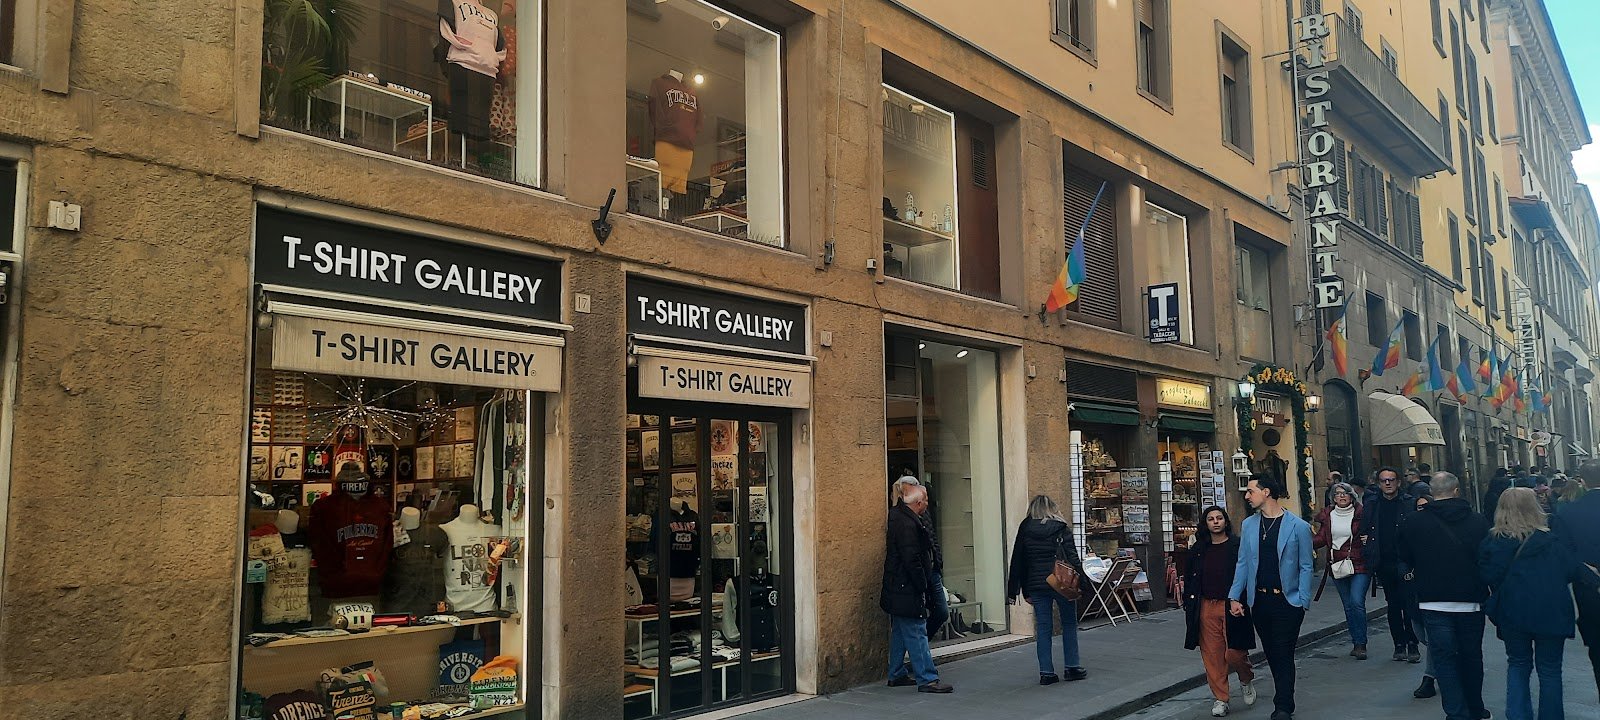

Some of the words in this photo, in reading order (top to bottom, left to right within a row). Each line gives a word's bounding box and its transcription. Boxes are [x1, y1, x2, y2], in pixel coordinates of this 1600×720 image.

[1299, 13, 1345, 308] RISTORANTE
[55, 206, 75, 226] 15
[283, 235, 407, 285] T-SHIRT
[415, 259, 542, 304] GALLERY
[577, 294, 588, 310] 17
[1151, 286, 1174, 327] T
[637, 295, 711, 330] T-SHIRT
[715, 309, 794, 342] GALLERY
[311, 329, 420, 366] T-SHIRT
[430, 343, 535, 377] GALLERY
[660, 365, 723, 392] T-SHIRT
[728, 373, 792, 397] GALLERY
[341, 482, 369, 492] FIRENZ
[439, 652, 484, 676] NIVERSIT
[329, 689, 376, 709] Firenze
